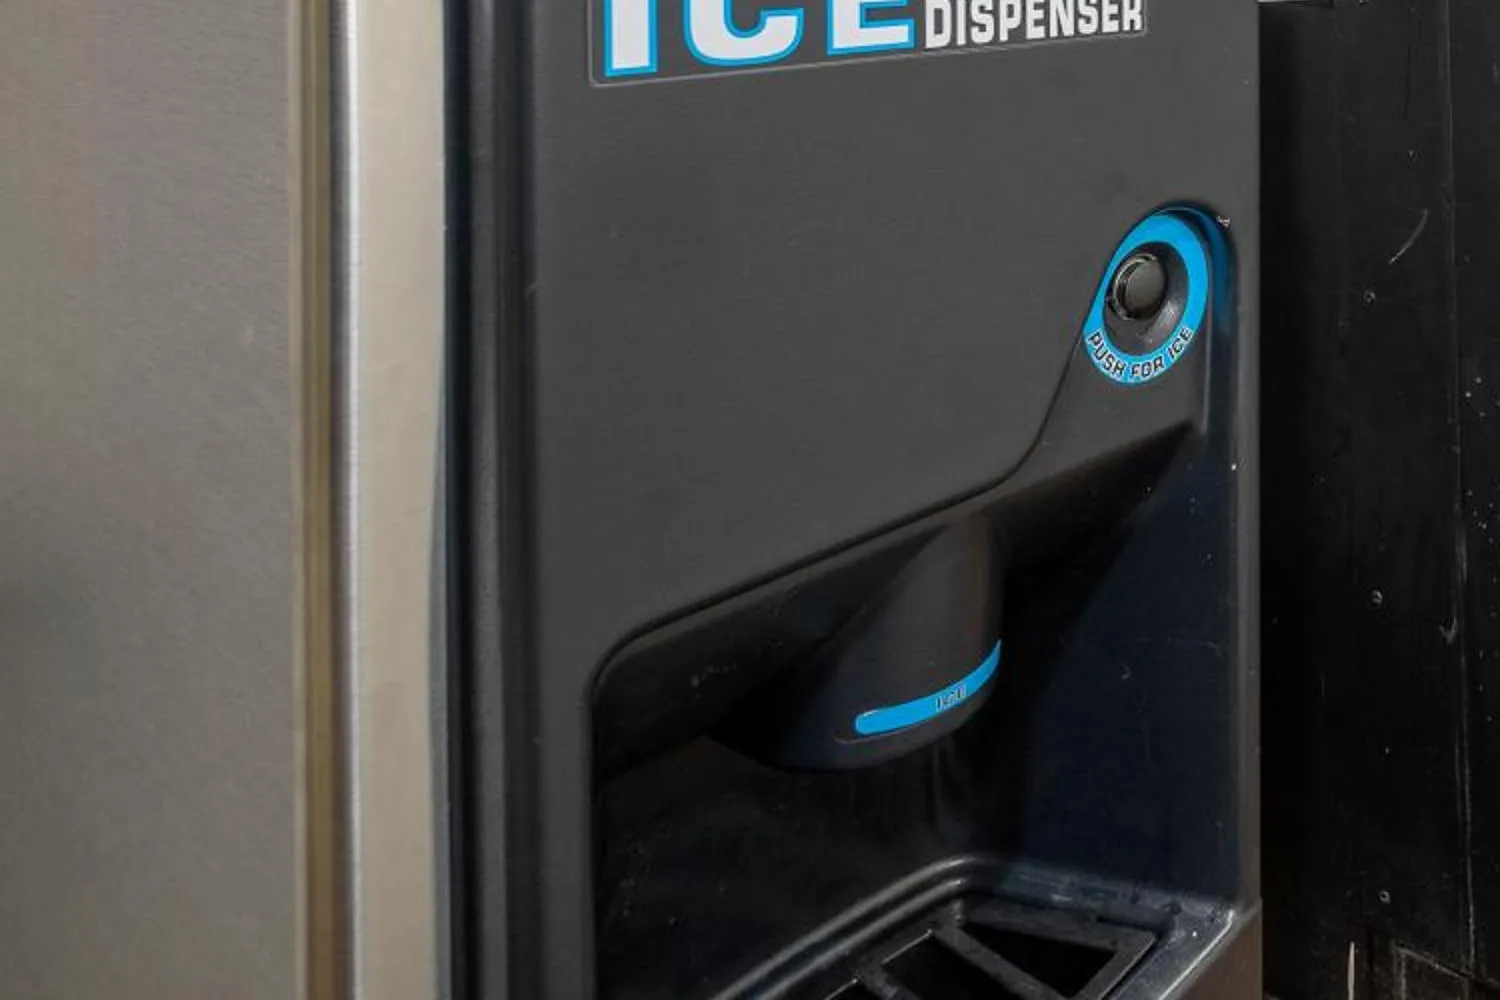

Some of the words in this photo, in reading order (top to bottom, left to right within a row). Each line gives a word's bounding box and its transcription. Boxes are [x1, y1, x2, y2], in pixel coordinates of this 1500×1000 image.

[1086, 328, 1126, 380] PUSH
[1129, 355, 1166, 380] FOR
[1167, 325, 1195, 359] ICE
